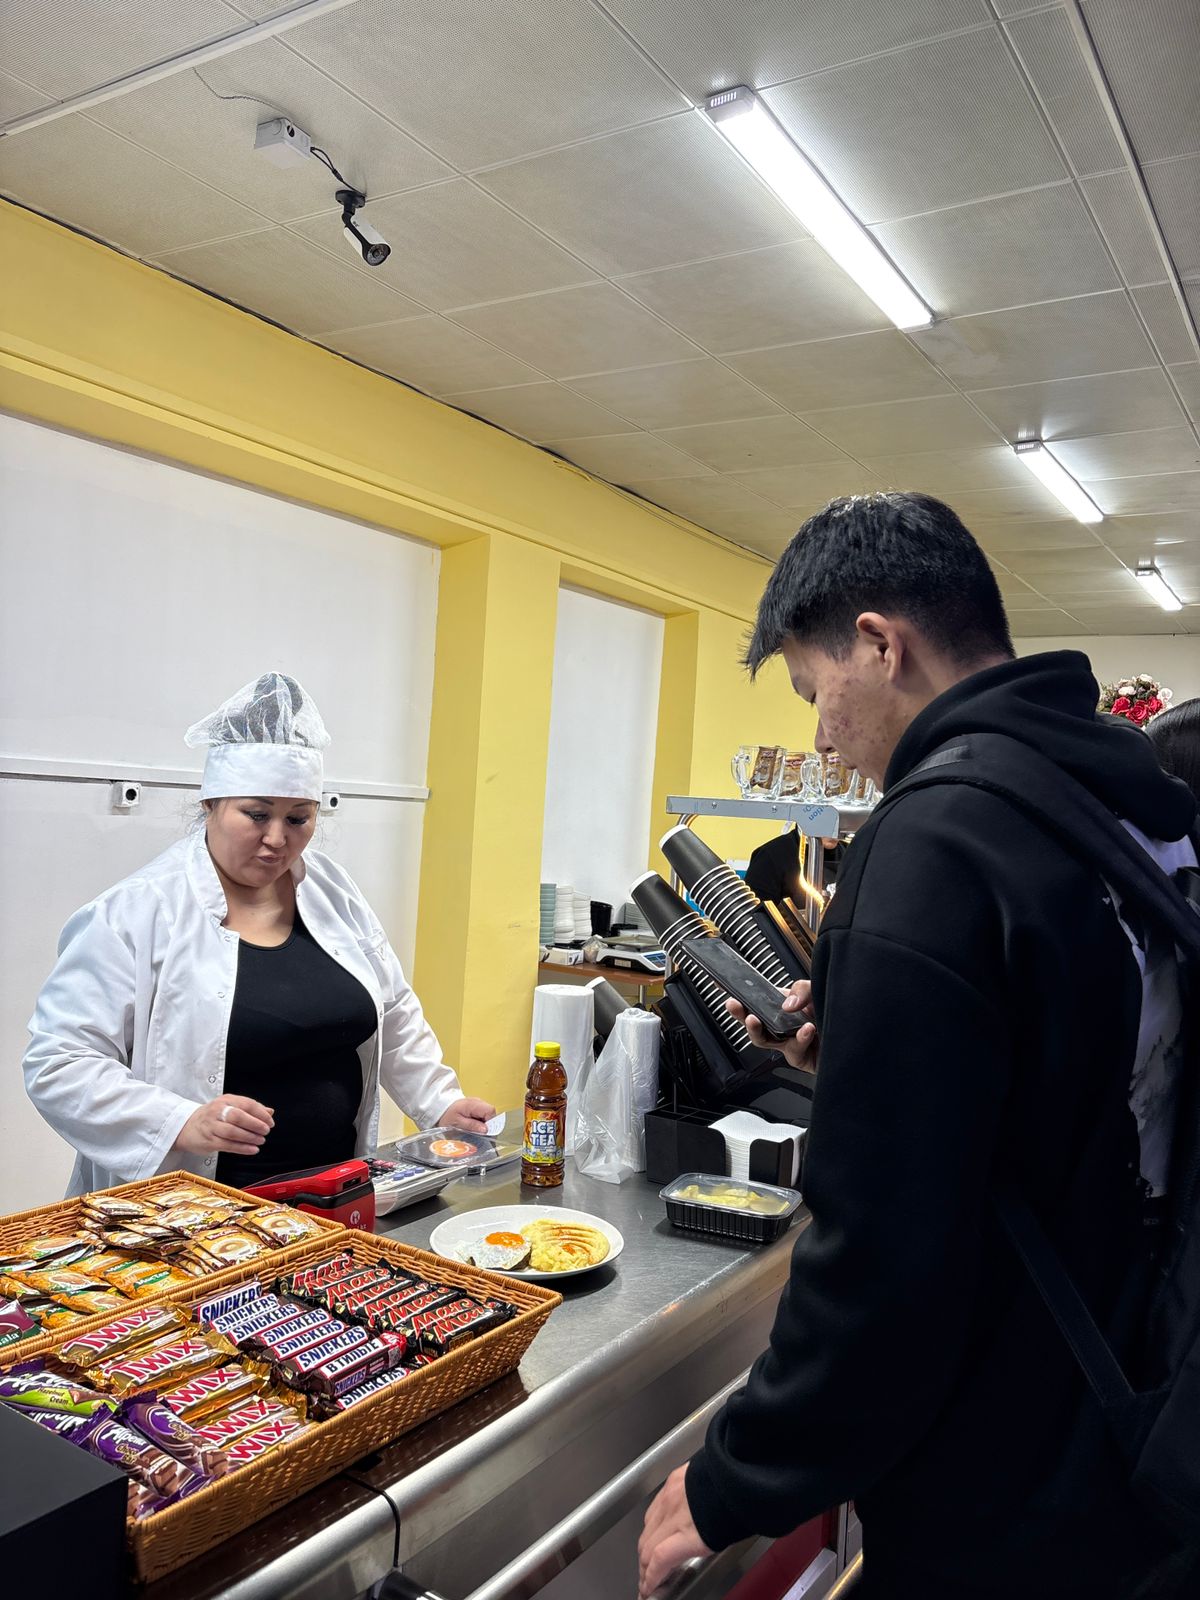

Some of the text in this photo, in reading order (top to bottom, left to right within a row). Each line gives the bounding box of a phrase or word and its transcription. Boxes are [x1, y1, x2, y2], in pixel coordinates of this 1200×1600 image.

[530, 1133, 556, 1146] TEA
[532, 1120, 554, 1134] ICE
[326, 1268, 389, 1310] Mars
[345, 1276, 405, 1315] Mar
[62, 1308, 163, 1353] TWIX
[215, 1295, 277, 1331] SNICKERS
[233, 1304, 297, 1340] SNICKERS
[264, 1309, 327, 1343] SNICKERS
[411, 1298, 474, 1340] Mars
[277, 1320, 341, 1355] SNICKERS
[298, 1327, 365, 1368] SNICKERS
[104, 1340, 207, 1382] TWIX
[49, 1395, 69, 1405] Cream
[343, 1368, 405, 1406] SNICKERS
[196, 1399, 283, 1446] TWIX
[227, 1420, 300, 1461] WIX
